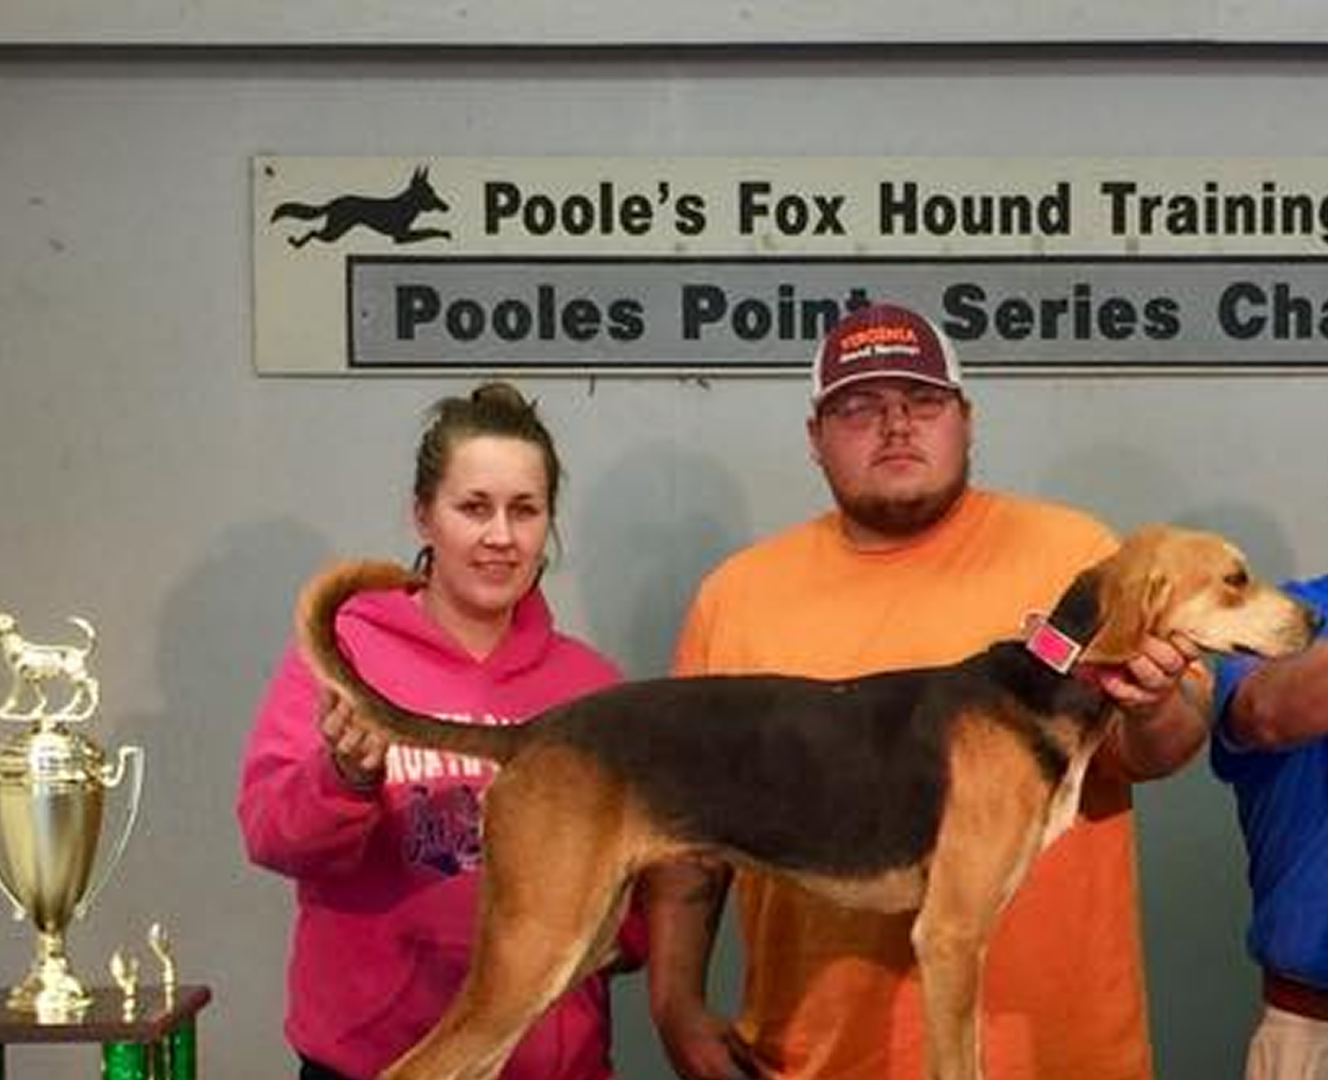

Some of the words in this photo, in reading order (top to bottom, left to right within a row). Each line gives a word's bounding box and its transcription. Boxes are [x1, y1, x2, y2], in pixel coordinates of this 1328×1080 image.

[484, 181, 706, 236] Poole's
[739, 181, 847, 236] Fox
[879, 181, 1072, 236] Hound
[396, 284, 645, 342] Pooles
[942, 283, 1180, 342] Series
